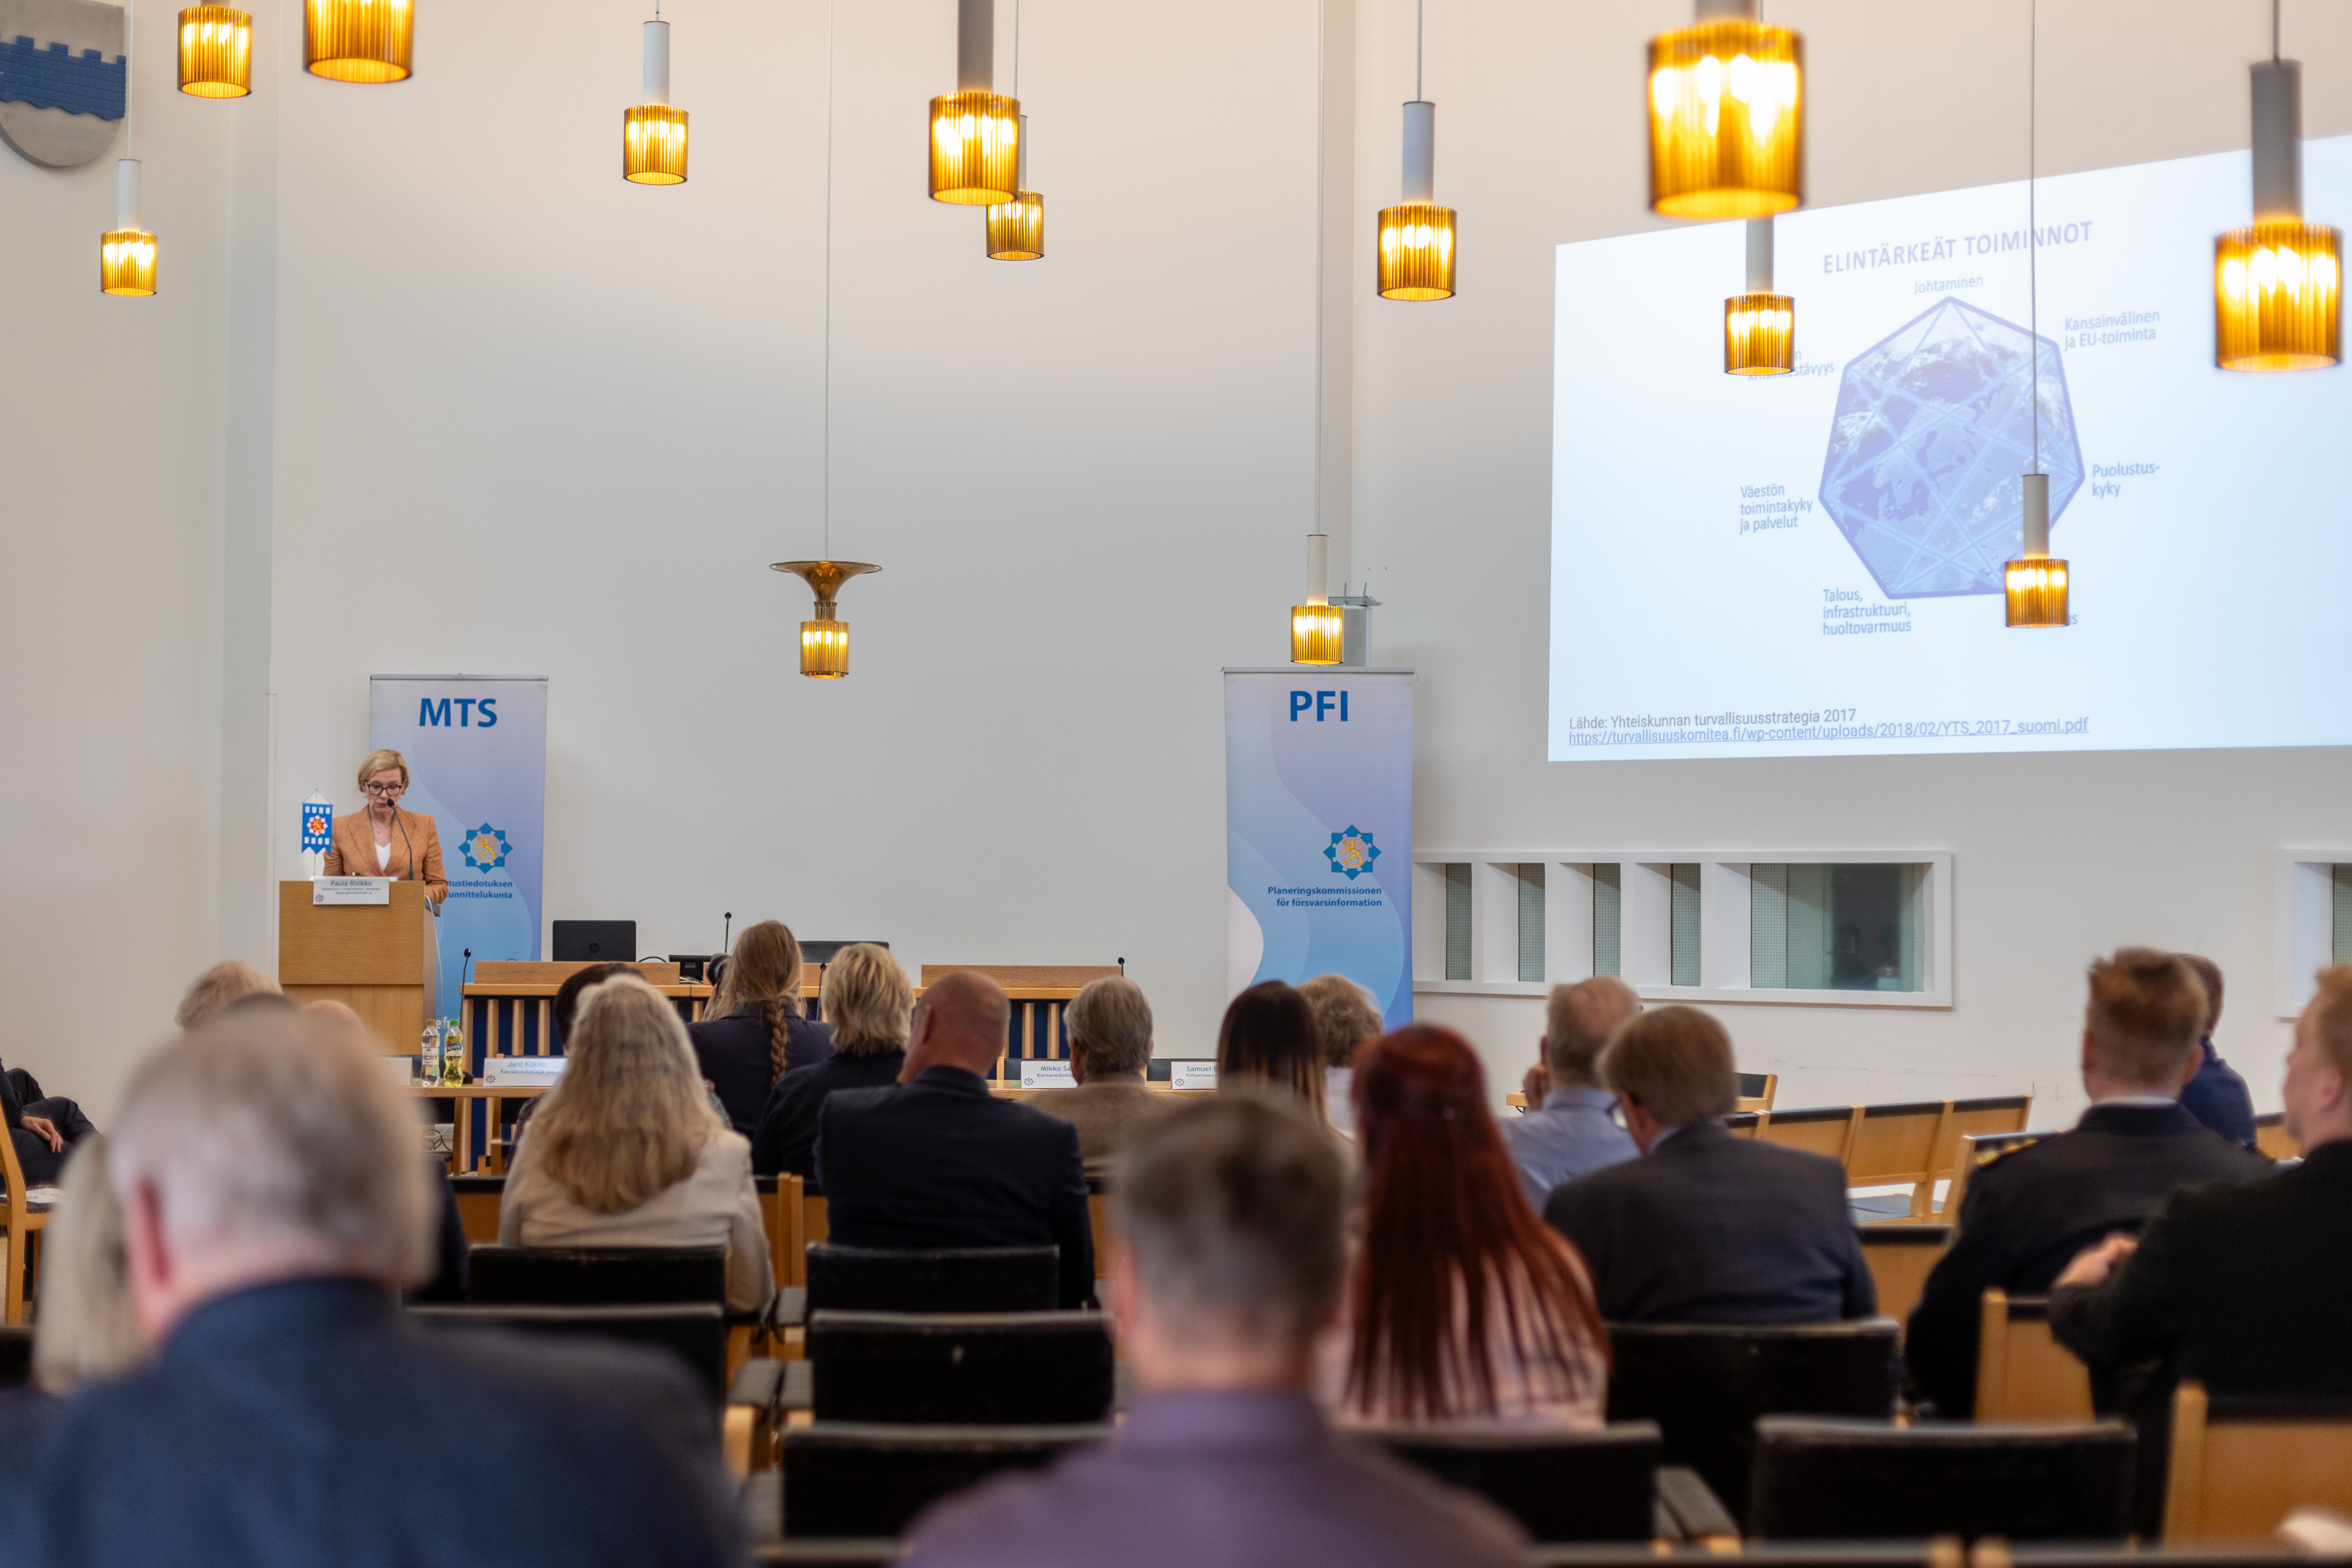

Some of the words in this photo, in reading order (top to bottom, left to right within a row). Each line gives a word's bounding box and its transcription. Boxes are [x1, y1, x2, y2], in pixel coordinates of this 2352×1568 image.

[1824, 236, 1957, 274] ELINTÄRKEÄT
[1965, 221, 2092, 256] TOIMINNOT
[1913, 275, 1983, 294] Johtaminen
[2065, 310, 2160, 331] Kansainvälinen
[2064, 335, 2075, 352] ja
[2080, 328, 2156, 347] EU-toiminta
[2092, 462, 2160, 478] Puolustus-
[1740, 483, 1785, 498] Väestön
[2092, 481, 2121, 499] kyky
[1740, 497, 1813, 515] toimintakyky
[1740, 519, 1750, 534] ja
[1753, 515, 1798, 533] palvelut
[1823, 588, 1863, 602] Talous,
[1823, 602, 1910, 619] infrastruktuuri,
[1823, 621, 1911, 635] huoltovarmuus
[419, 698, 497, 728] MTS
[1290, 690, 1348, 721] PFI
[1570, 715, 1608, 729] Lähde:
[1611, 714, 1691, 728] Yhteiskunnan
[1694, 710, 1820, 726] turvallisuusstrategia
[1824, 709, 1856, 722] 2017
[1569, 717, 2089, 746] https://turvallisuuskomitea.fi/wp-content/uploads/2018/02/YTS_2017_suomi.pdf
[1268, 887, 1382, 896] Planeringskommissionen
